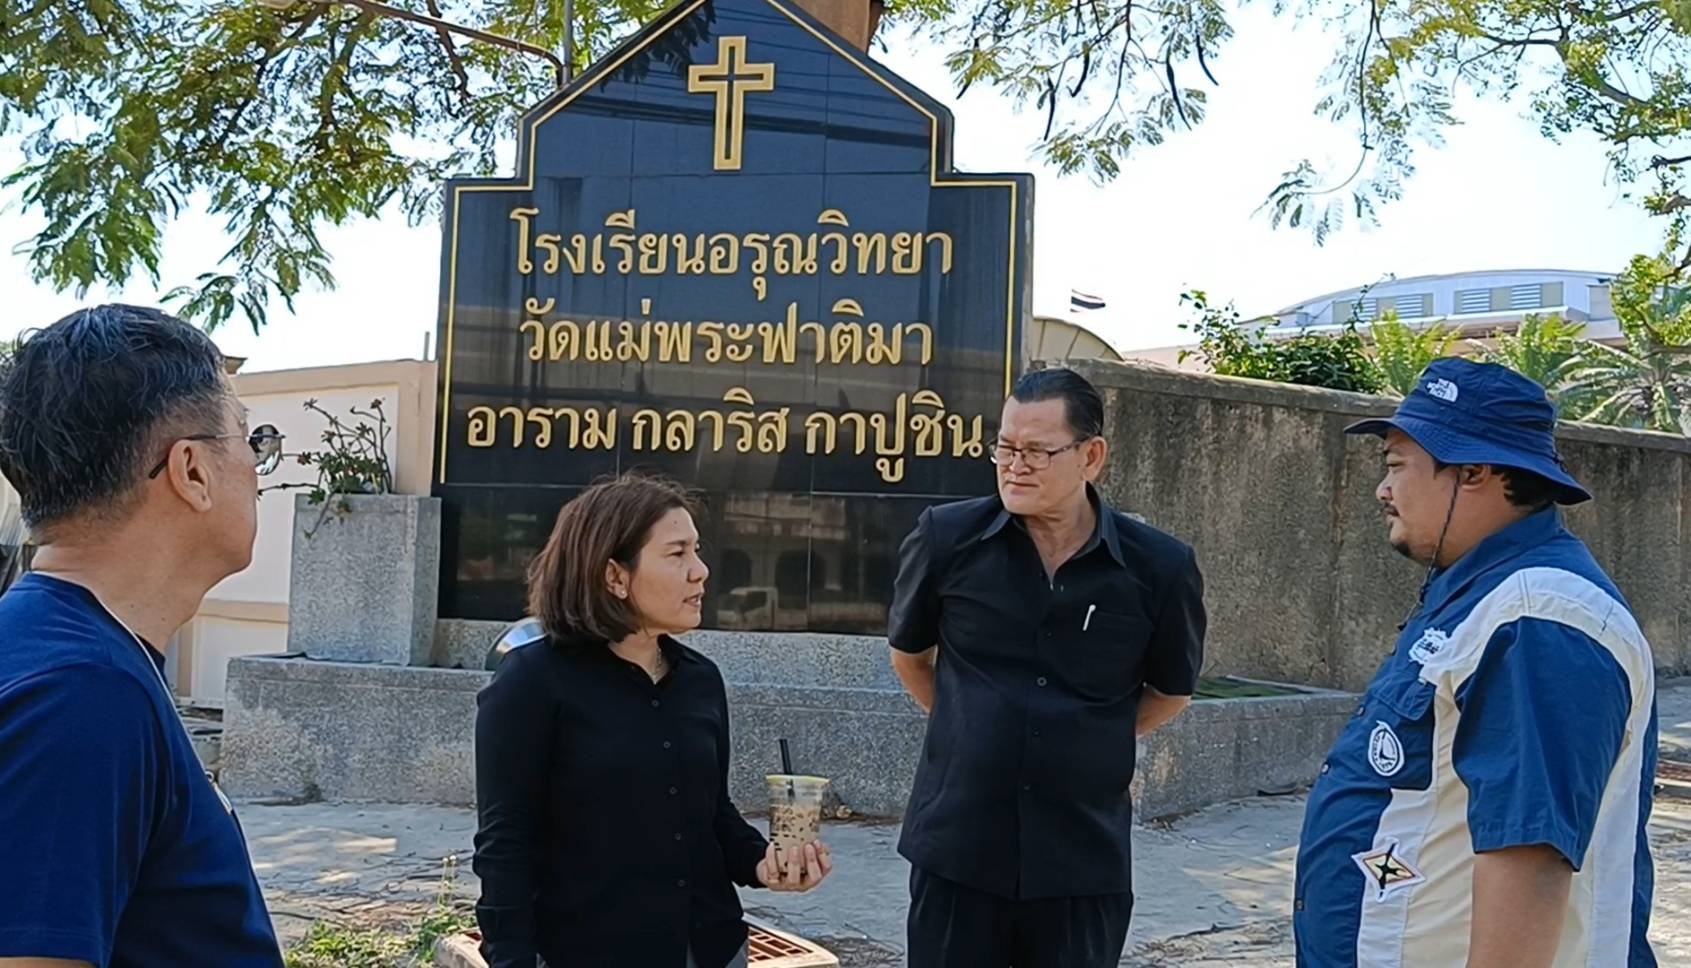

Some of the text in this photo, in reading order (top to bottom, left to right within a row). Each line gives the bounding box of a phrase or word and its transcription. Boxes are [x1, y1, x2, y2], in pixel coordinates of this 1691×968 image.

[509, 207, 953, 301] โรงเรียนอรุณวิทยา
[519, 298, 934, 366] วัดแม่พระฟาติมา
[467, 386, 984, 482] อาราม กลาริส กาปูชิน
